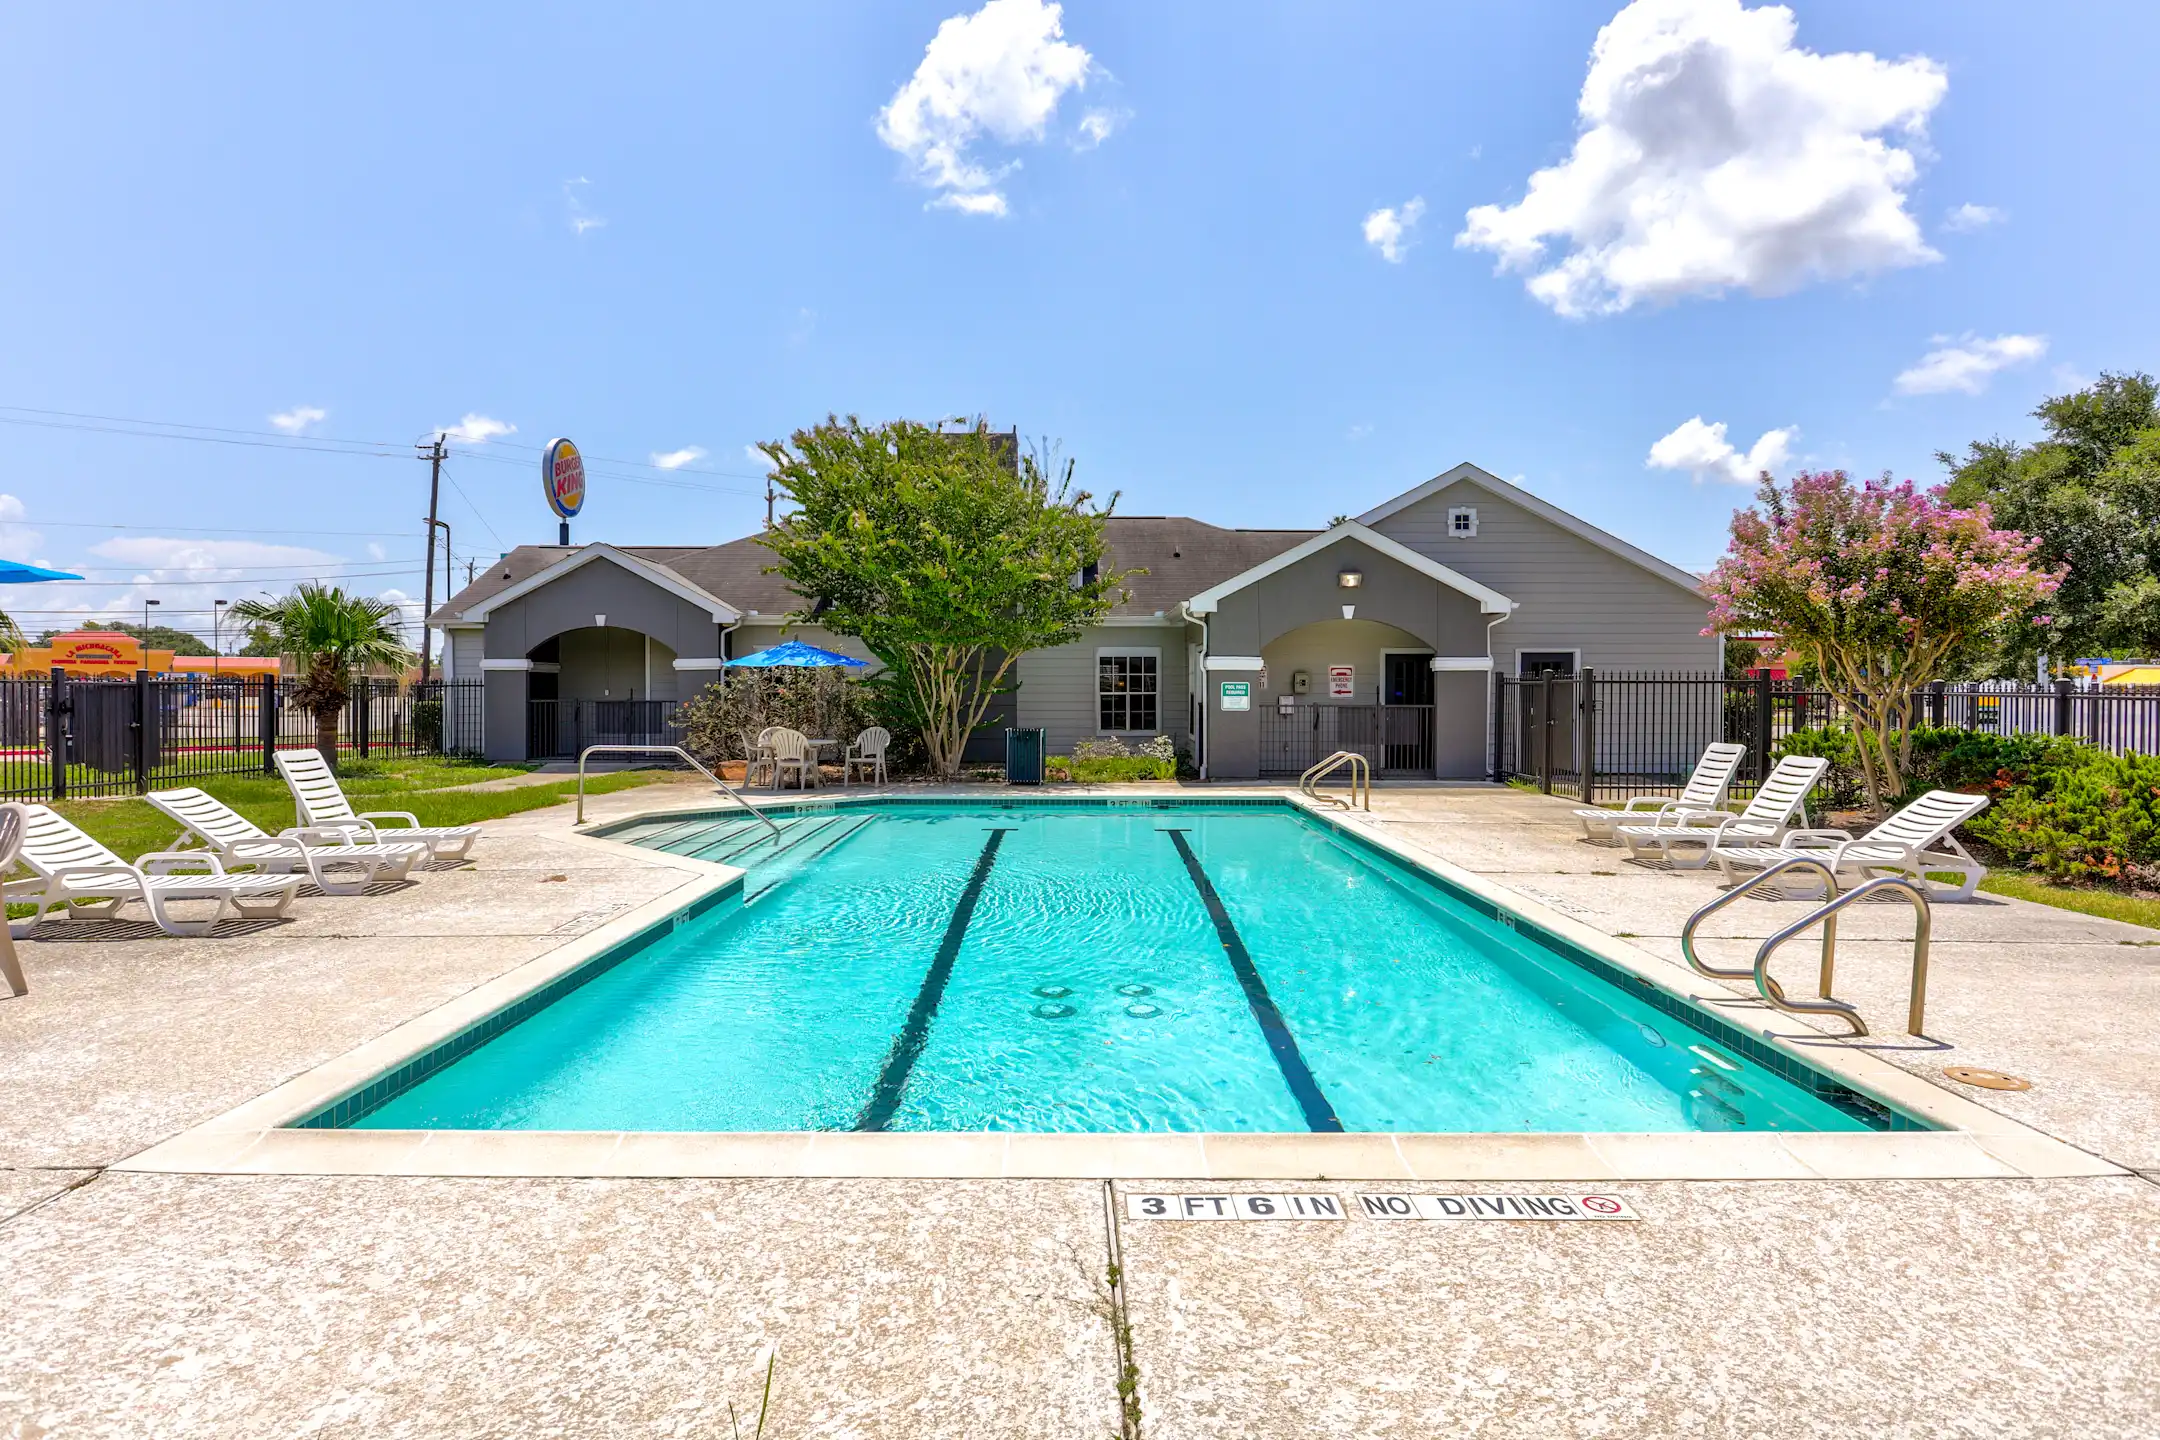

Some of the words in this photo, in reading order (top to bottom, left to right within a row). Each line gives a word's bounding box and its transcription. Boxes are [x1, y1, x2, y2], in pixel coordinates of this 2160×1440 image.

[556, 470, 583, 498] KING
[65, 650, 76, 658] LA
[1141, 1196, 1167, 1216] 3
[1184, 1196, 1227, 1216] FT
[1247, 1196, 1276, 1216] 6
[1292, 1196, 1338, 1216] IN
[1361, 1196, 1412, 1216] NO
[1436, 1196, 1578, 1217] DIVING
